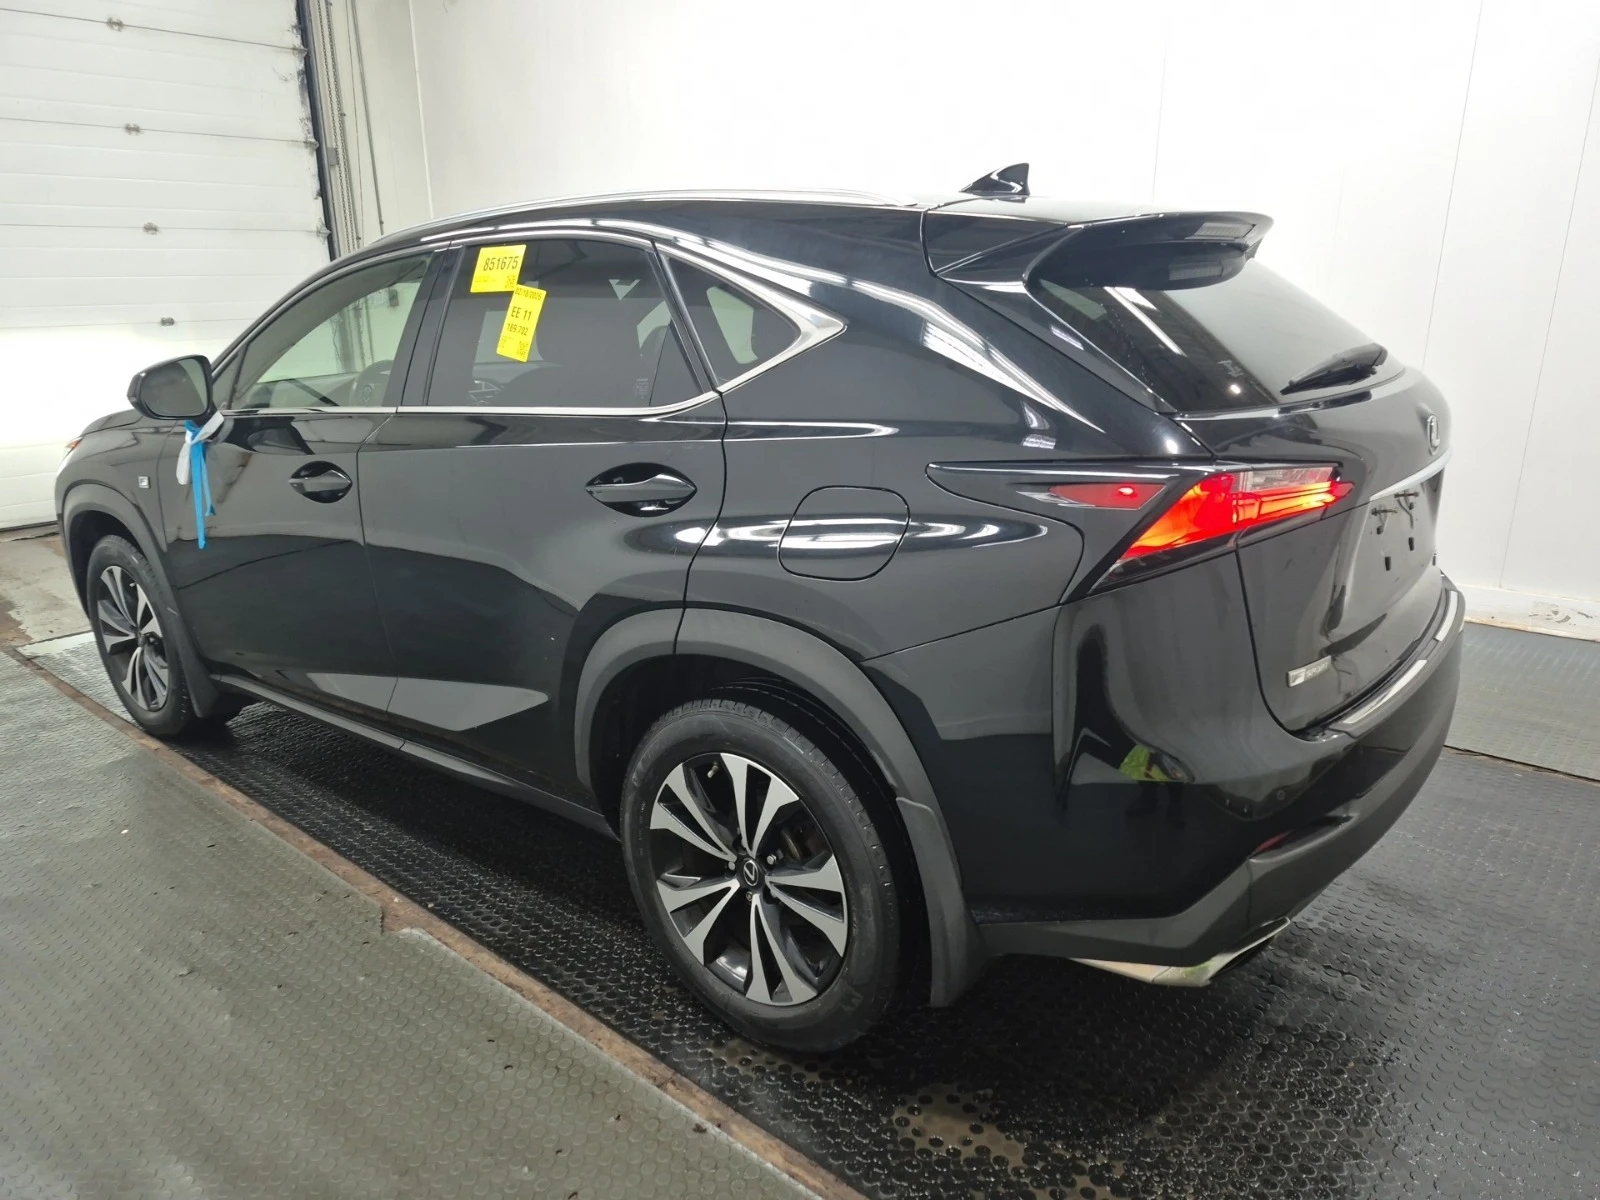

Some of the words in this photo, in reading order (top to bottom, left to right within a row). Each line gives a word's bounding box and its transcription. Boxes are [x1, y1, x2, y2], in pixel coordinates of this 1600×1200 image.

[483, 255, 520, 272] 851675
[511, 306, 522, 319] EE
[523, 309, 533, 321] 11
